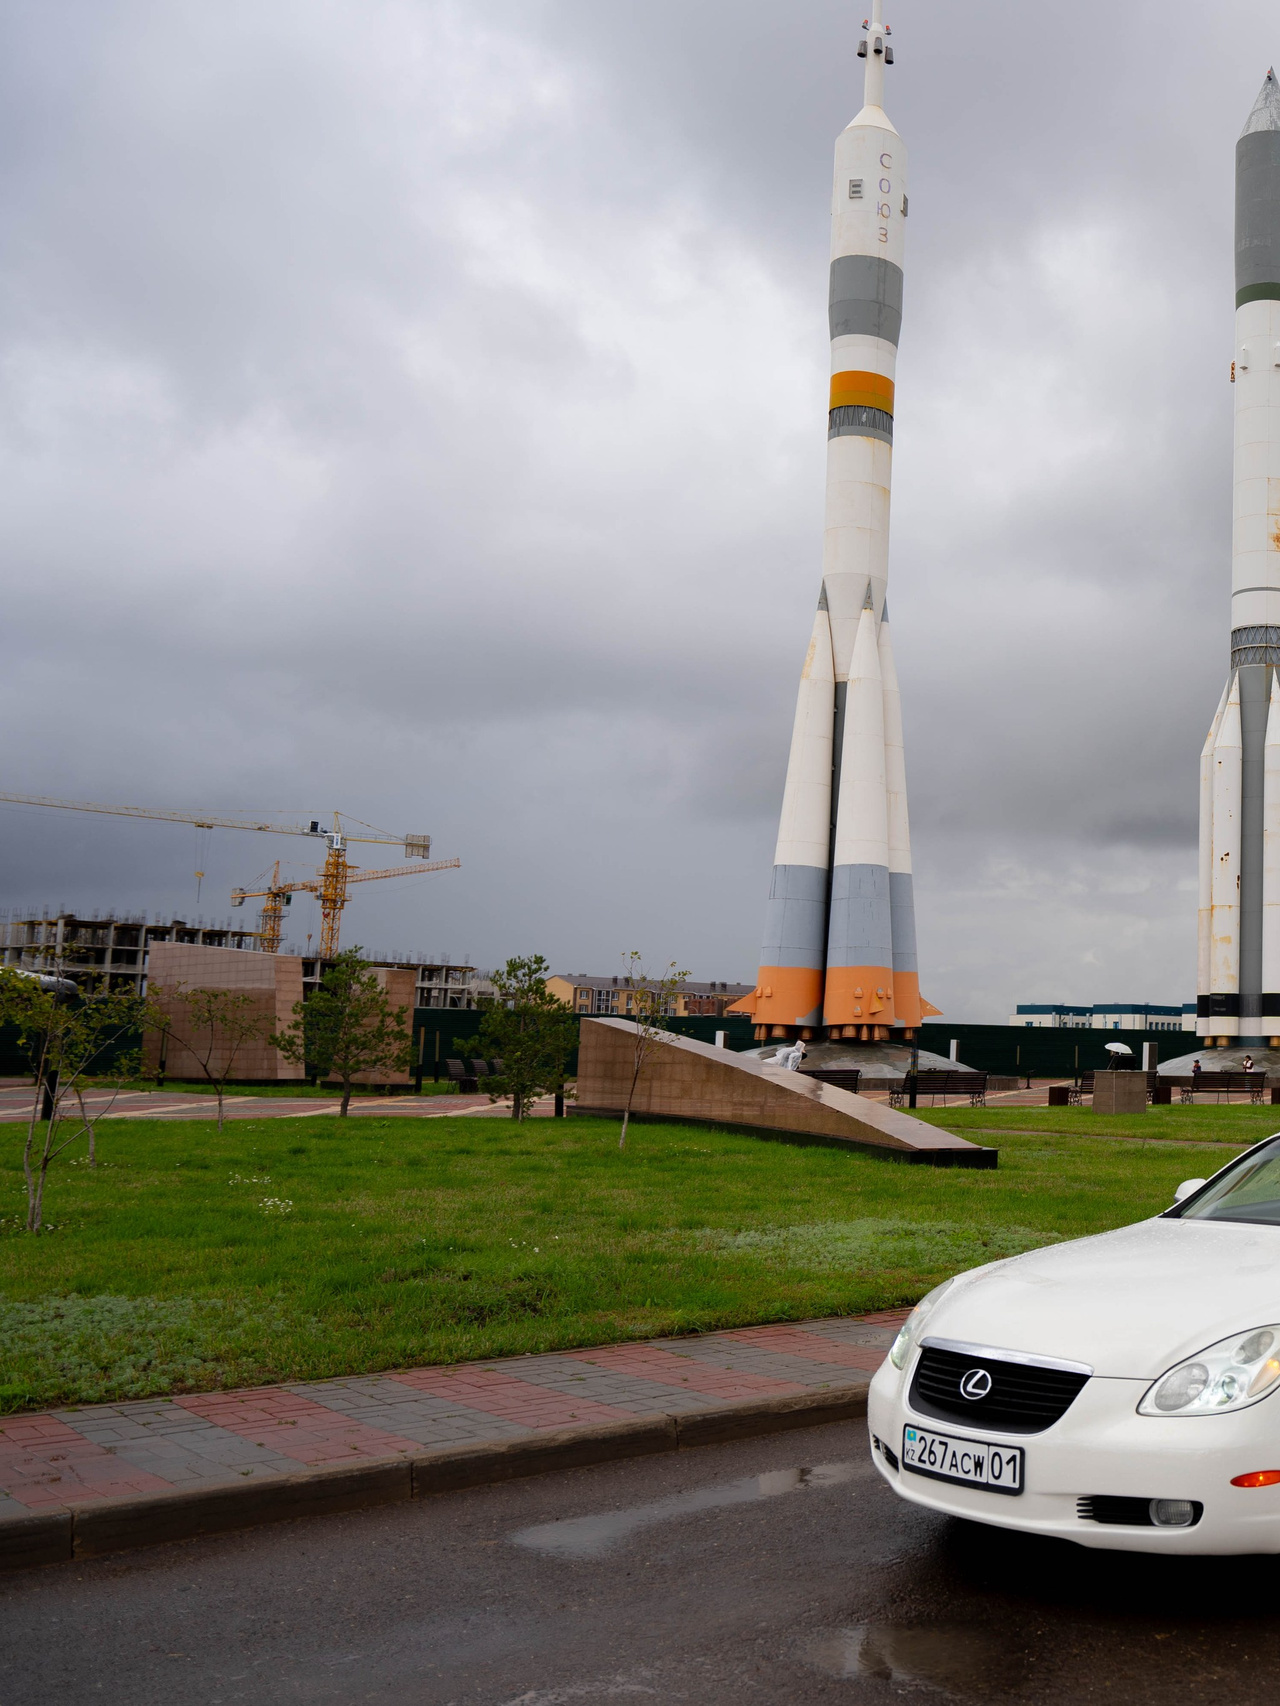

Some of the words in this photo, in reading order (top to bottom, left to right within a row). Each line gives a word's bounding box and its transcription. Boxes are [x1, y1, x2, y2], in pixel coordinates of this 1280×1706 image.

[877, 153, 893, 243] СОЮЗ
[905, 1447, 916, 1461] KZ
[990, 1451, 1018, 1484] 01
